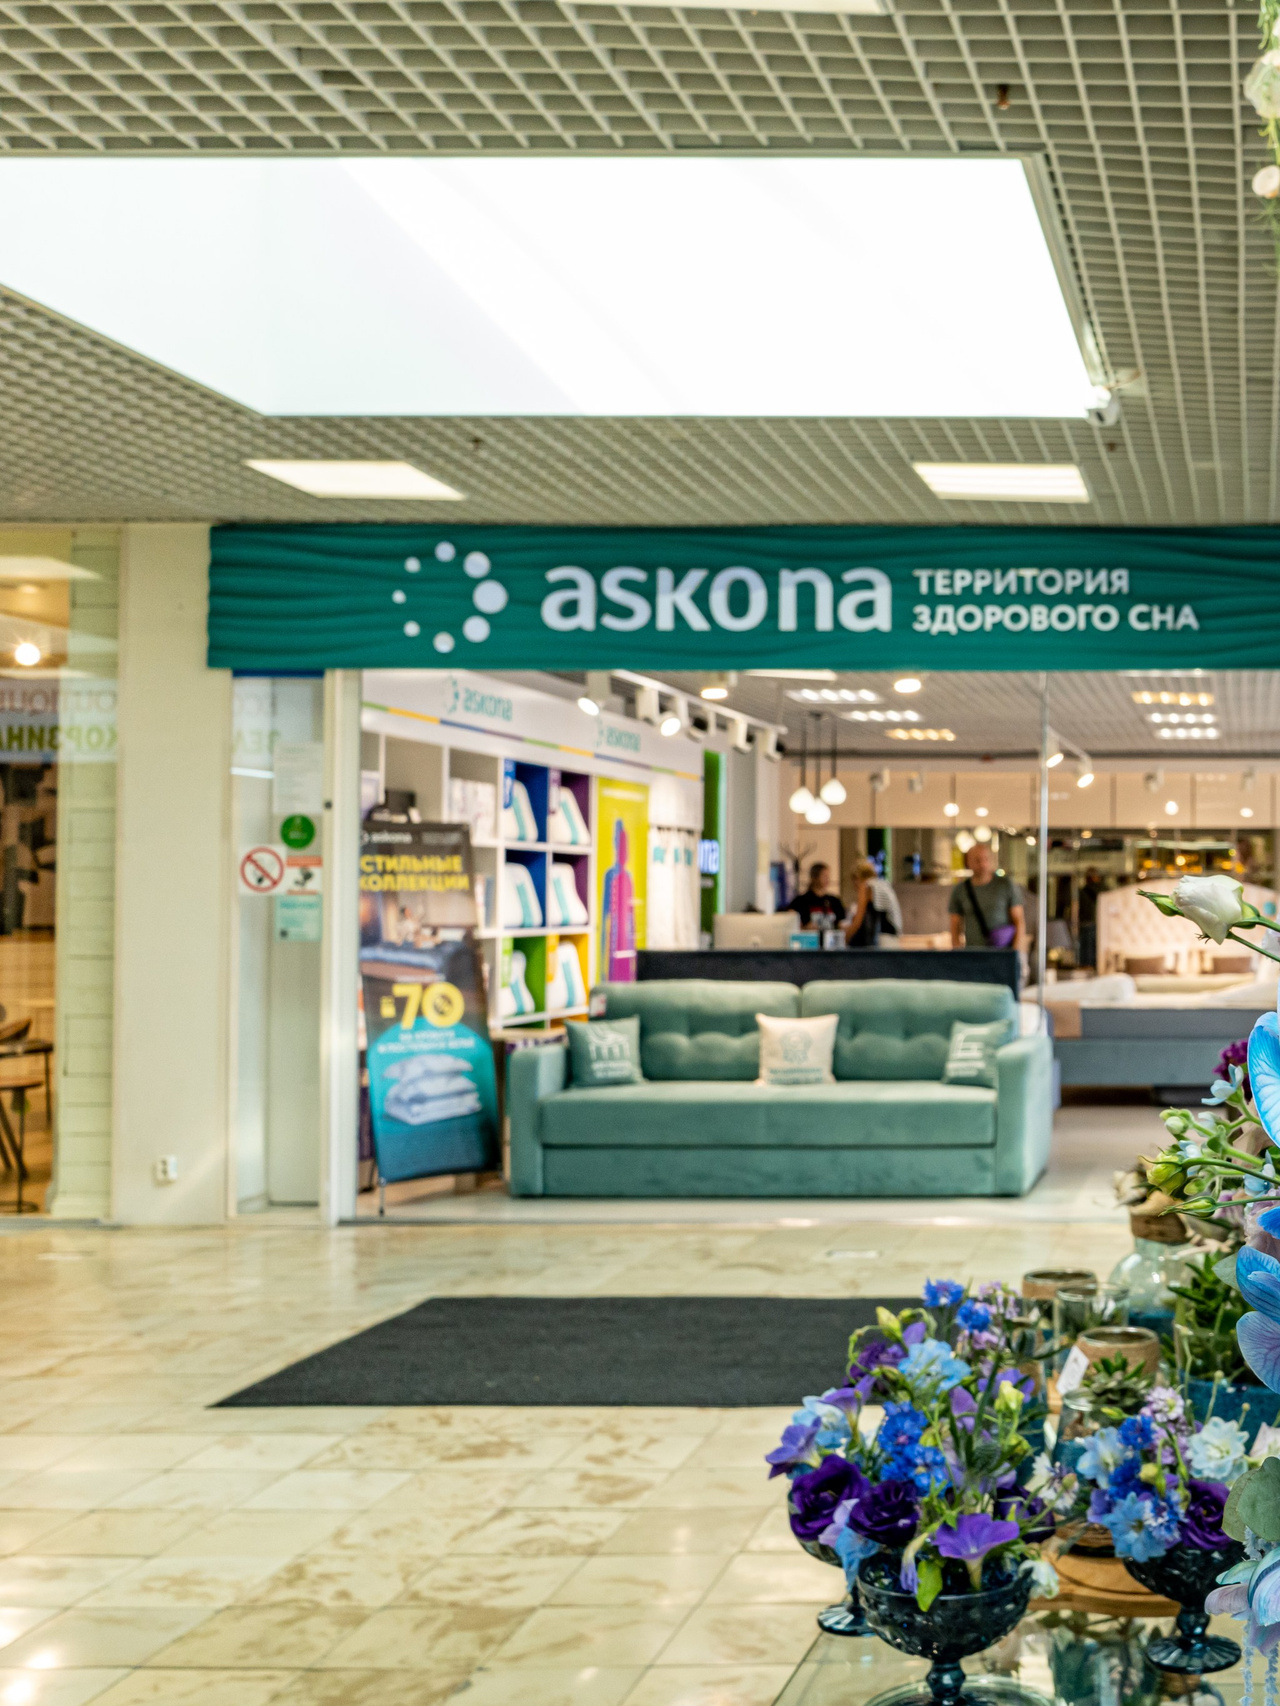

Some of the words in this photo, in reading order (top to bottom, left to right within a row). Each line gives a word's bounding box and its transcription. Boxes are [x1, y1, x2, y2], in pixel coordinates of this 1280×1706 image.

[913, 568, 1129, 596] ТЕРРИТОРИЯ
[541, 567, 892, 632] askona
[912, 604, 1119, 635] ЗДОРОВОГО
[1128, 604, 1199, 631] СНА
[360, 854, 463, 873] СТИЛЬНЫЕ
